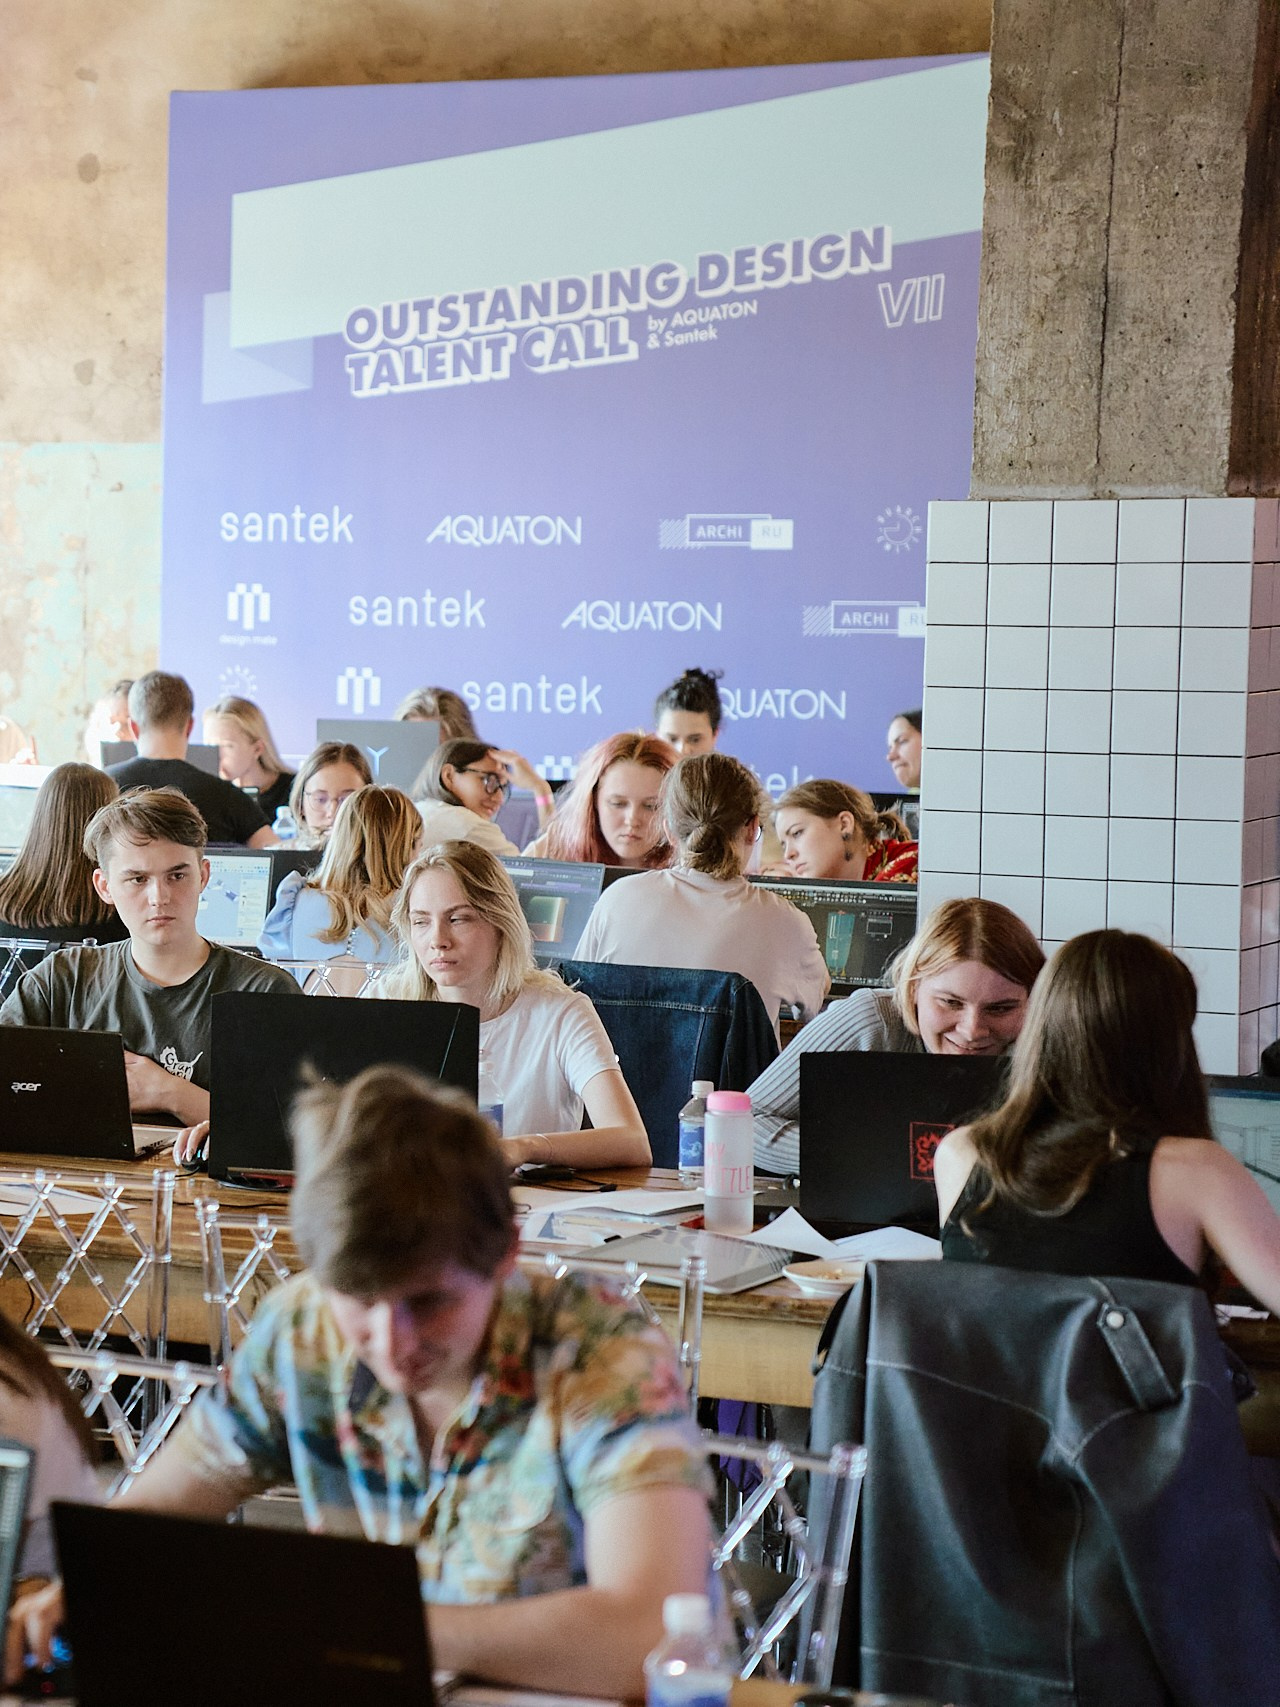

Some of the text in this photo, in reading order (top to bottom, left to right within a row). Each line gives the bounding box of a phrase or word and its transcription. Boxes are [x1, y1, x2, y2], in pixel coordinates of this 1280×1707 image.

[342, 225, 892, 350] OUTSTANDING DESIGN
[878, 273, 945, 328] VII
[647, 299, 758, 335] by AQUATON
[646, 323, 718, 349] & Santek
[345, 316, 639, 398] TALENT CALL
[220, 505, 354, 543] santek
[426, 515, 582, 547] AQUATON
[696, 525, 742, 539] ARCHI
[349, 588, 486, 628] santek
[561, 600, 721, 633] AQUATON
[841, 612, 889, 626] ARCHI
[462, 674, 603, 715] santek
[720, 687, 846, 720] QUATON
[165, 1052, 192, 1075] Gran
[11, 1082, 41, 1093] acer
